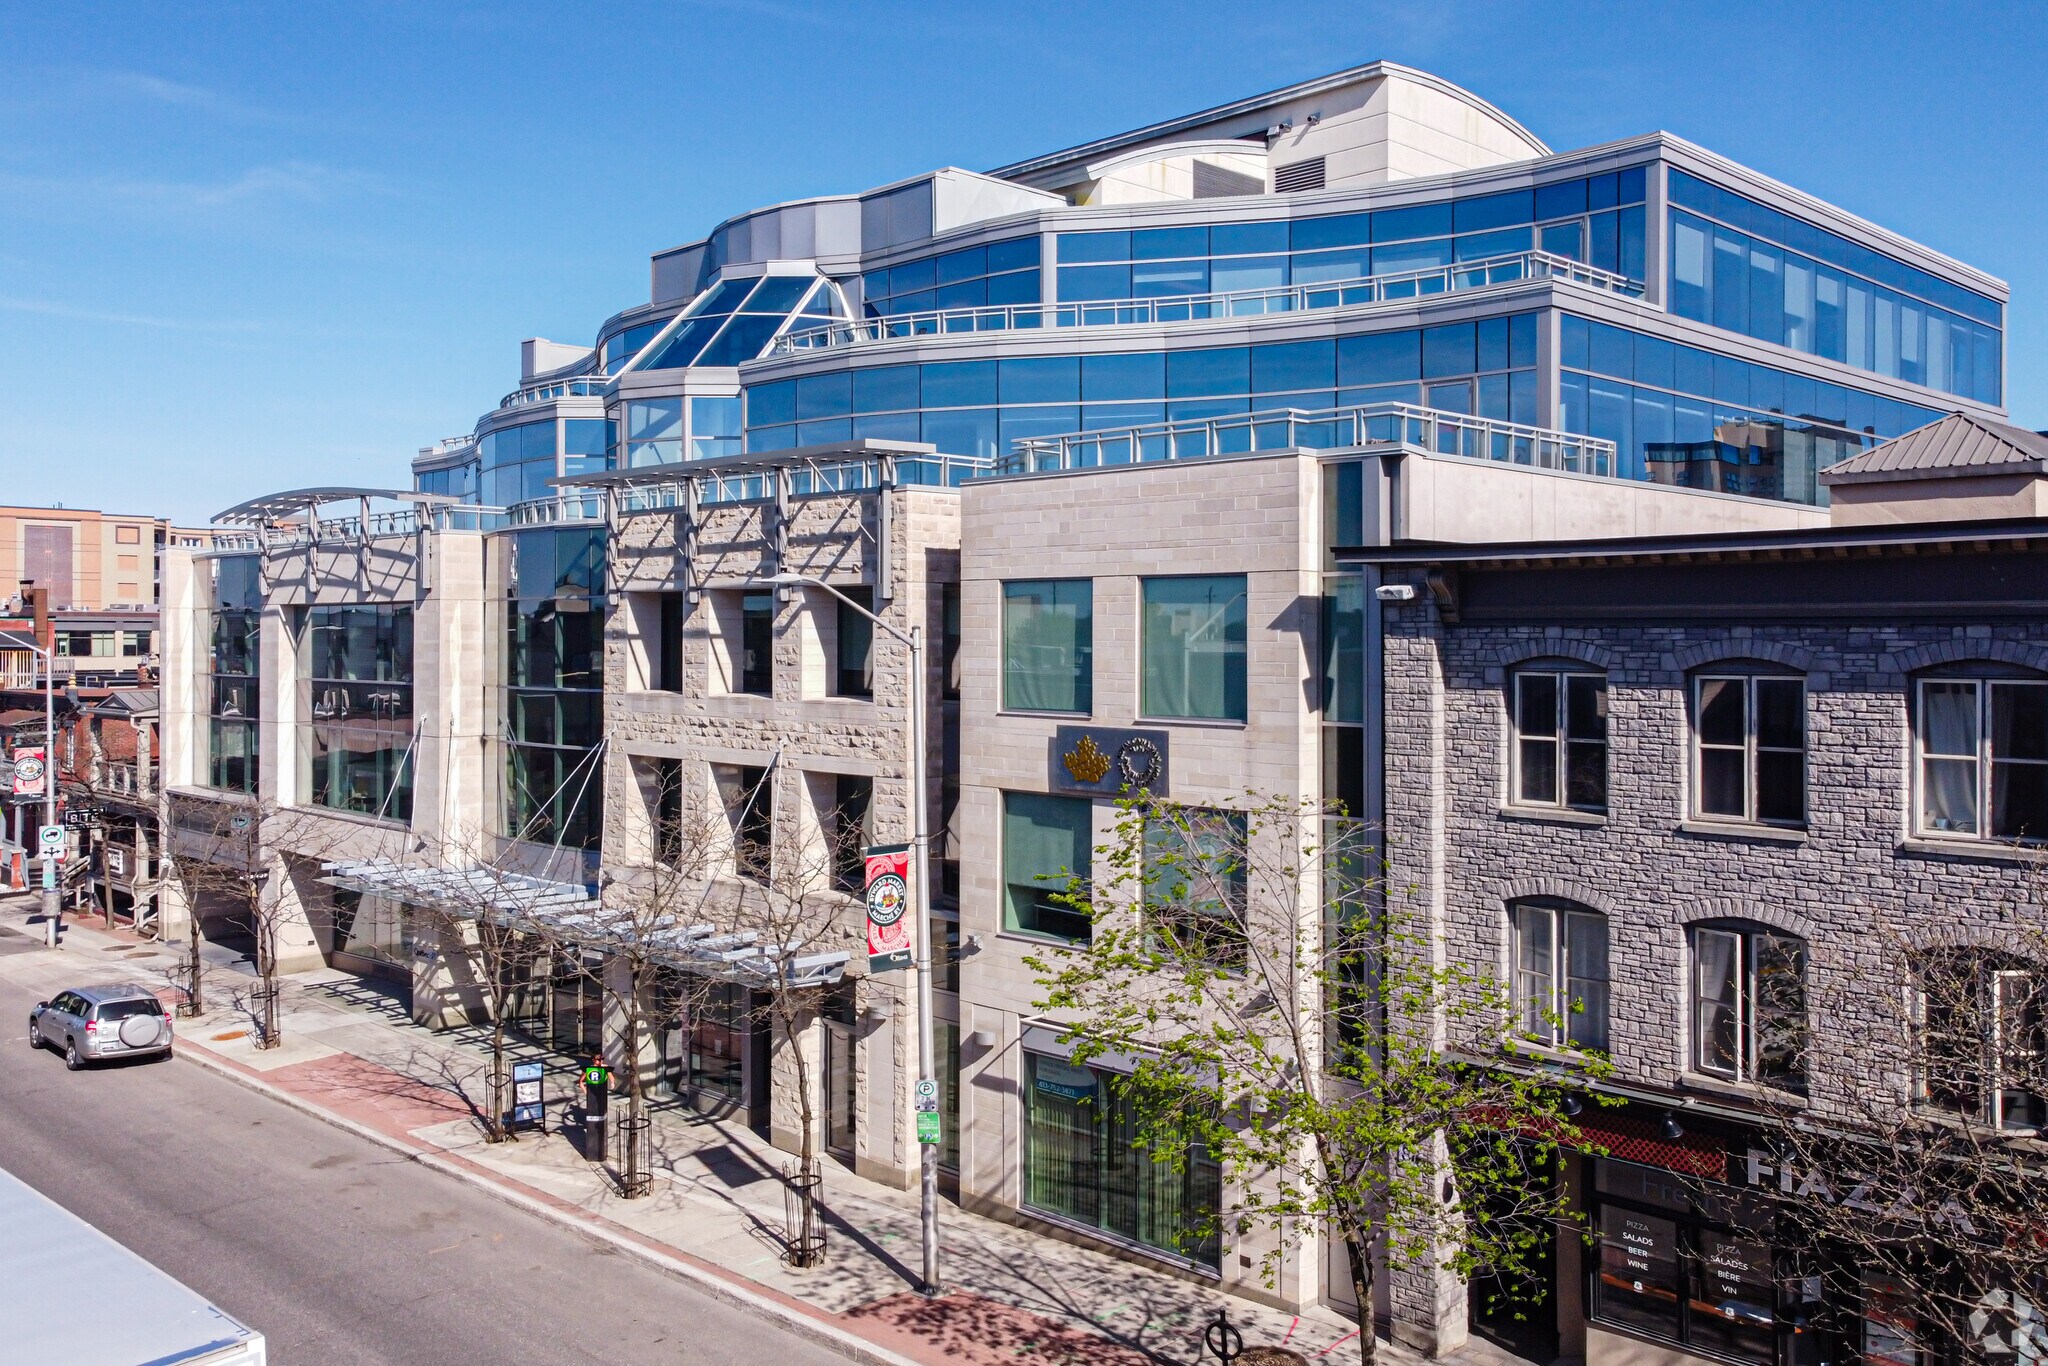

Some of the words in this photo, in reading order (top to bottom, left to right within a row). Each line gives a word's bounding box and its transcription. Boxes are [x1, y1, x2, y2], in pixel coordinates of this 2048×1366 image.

[869, 879, 888, 902] BYWARD
[888, 878, 904, 896] MARKET
[1626, 1220, 1650, 1232] PIZZA
[1622, 1231, 1654, 1246] SALADS
[1628, 1246, 1648, 1258] BEER
[1716, 1243, 1741, 1256] PIZZA
[1627, 1258, 1649, 1271] WINE
[1710, 1254, 1749, 1271] SALADES
[1717, 1270, 1741, 1283] BIÈRE
[1721, 1284, 1738, 1295] VIN
